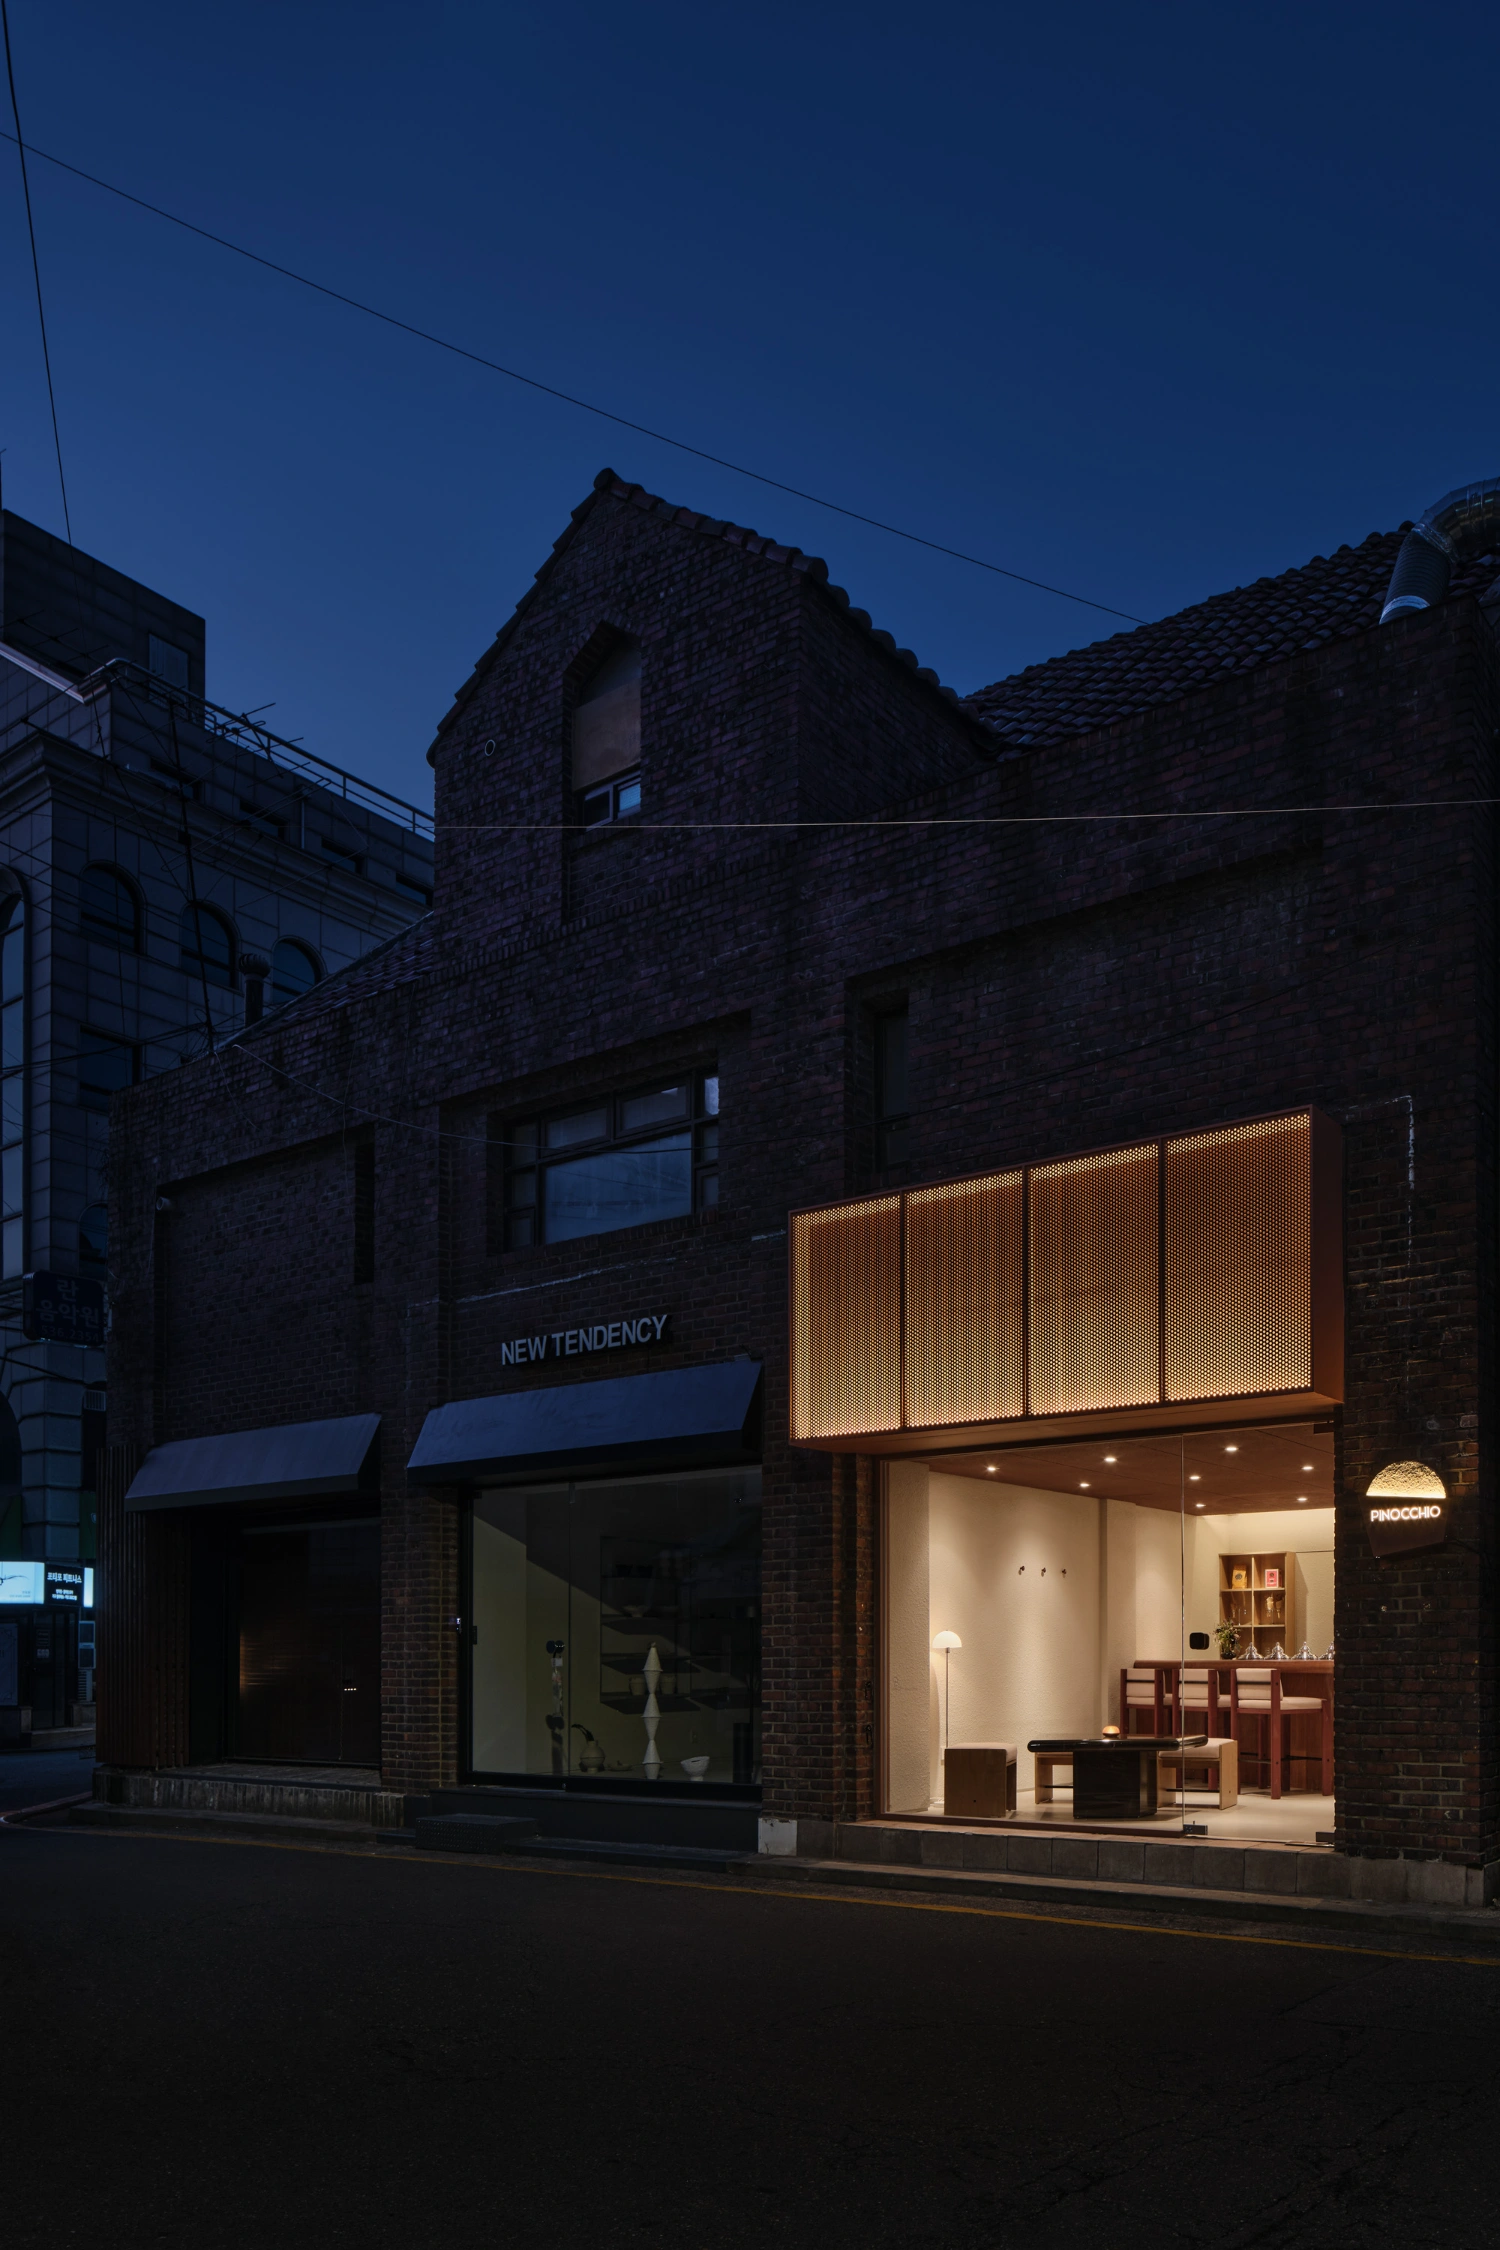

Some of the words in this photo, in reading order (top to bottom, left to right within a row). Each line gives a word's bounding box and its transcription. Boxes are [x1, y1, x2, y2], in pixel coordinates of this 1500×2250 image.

[56, 1279, 80, 1303] 란
[35, 1299, 100, 1329] 음악원
[501, 1335, 548, 1366] NEW
[551, 1314, 668, 1357] TENDENCY
[1370, 1505, 1441, 1522] PINOCCHIO
